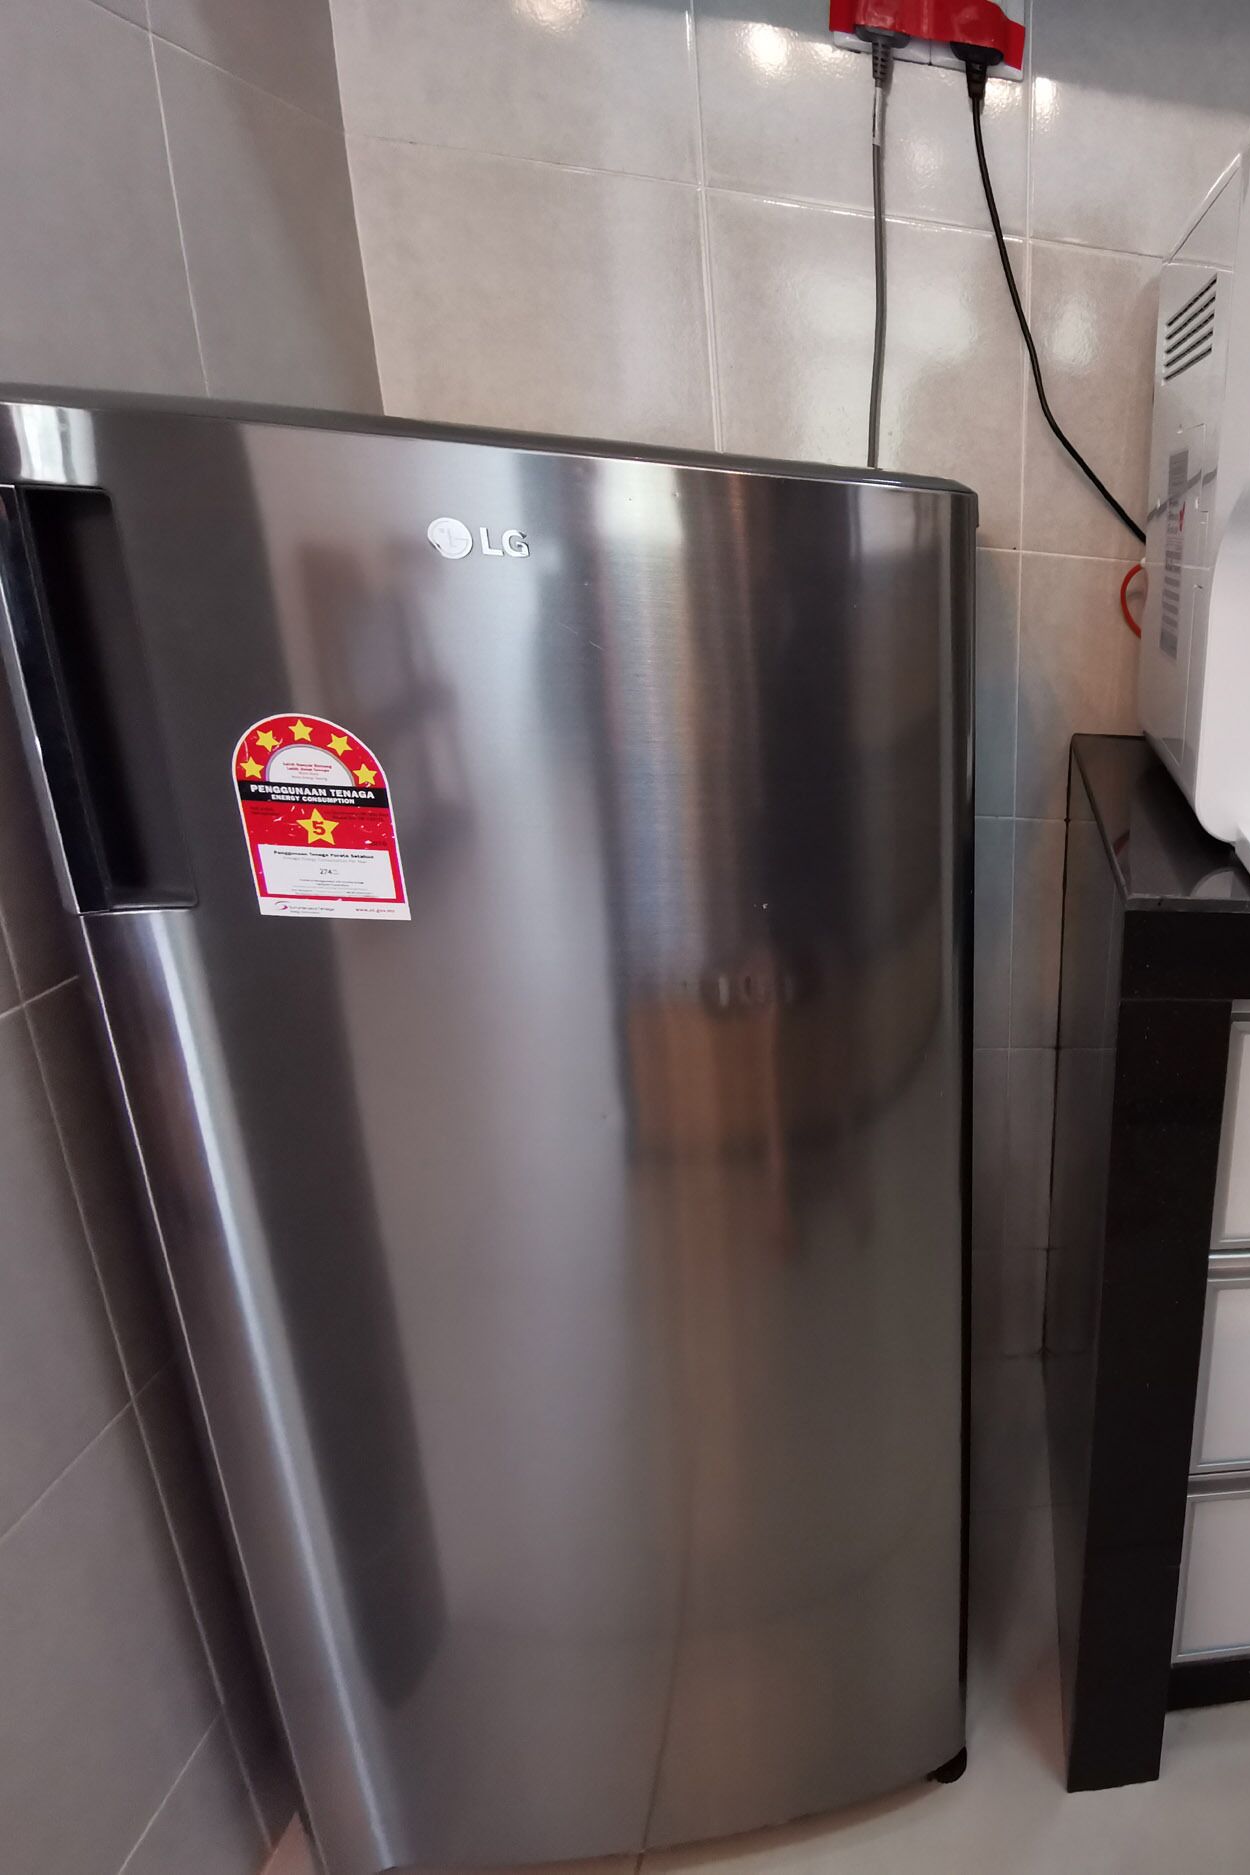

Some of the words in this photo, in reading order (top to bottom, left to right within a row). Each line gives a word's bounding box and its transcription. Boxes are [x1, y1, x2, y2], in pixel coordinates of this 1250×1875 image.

[480, 527, 530, 558] LG
[250, 784, 327, 797] PENGGUNAAN
[329, 789, 375, 799] TENAGA
[271, 794, 300, 802] ENERGY
[302, 796, 355, 804] CONSUMPTION
[312, 821, 326, 836] 5
